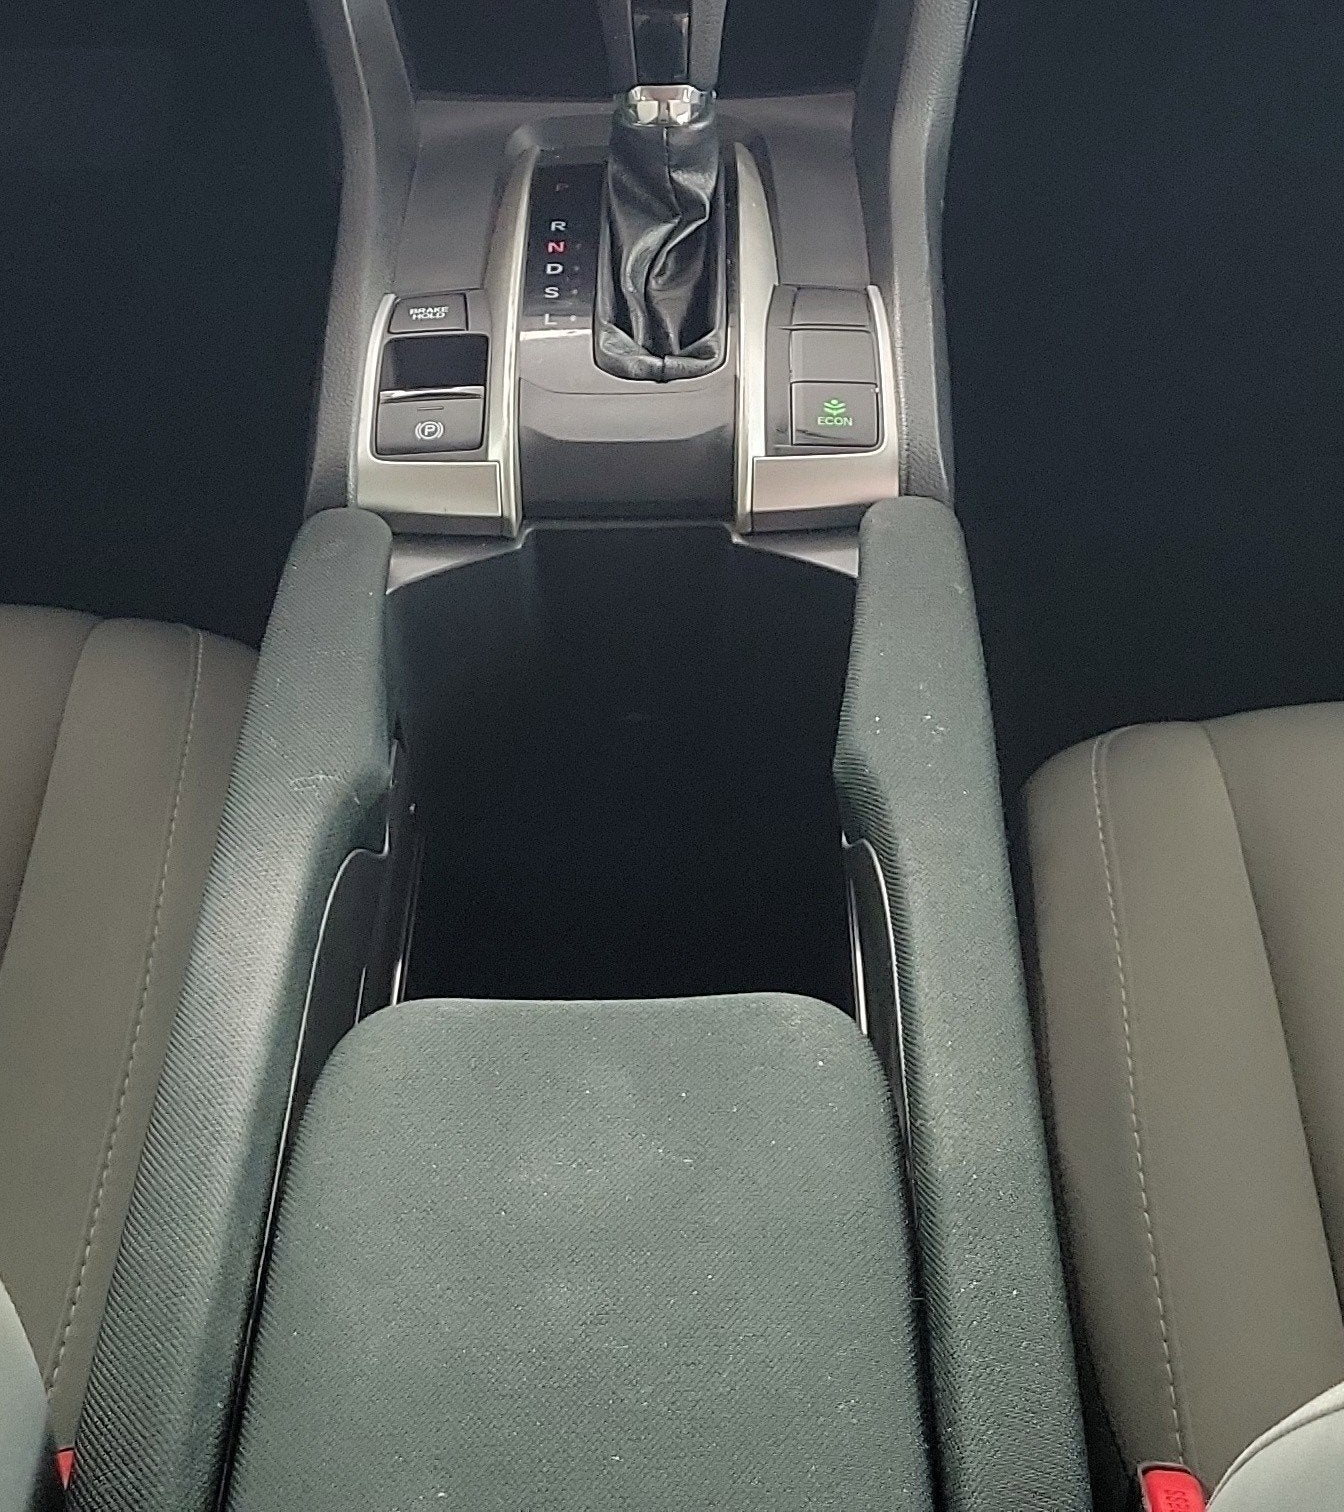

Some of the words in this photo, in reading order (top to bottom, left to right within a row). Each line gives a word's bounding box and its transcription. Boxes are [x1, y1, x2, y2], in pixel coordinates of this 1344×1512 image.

[550, 221, 567, 231] R
[547, 241, 565, 253] N
[546, 263, 564, 275] D
[544, 286, 559, 299] S
[409, 306, 449, 315] BRAKE
[412, 312, 446, 320] HOLD
[544, 313, 558, 325] L
[817, 416, 853, 427] ECON
